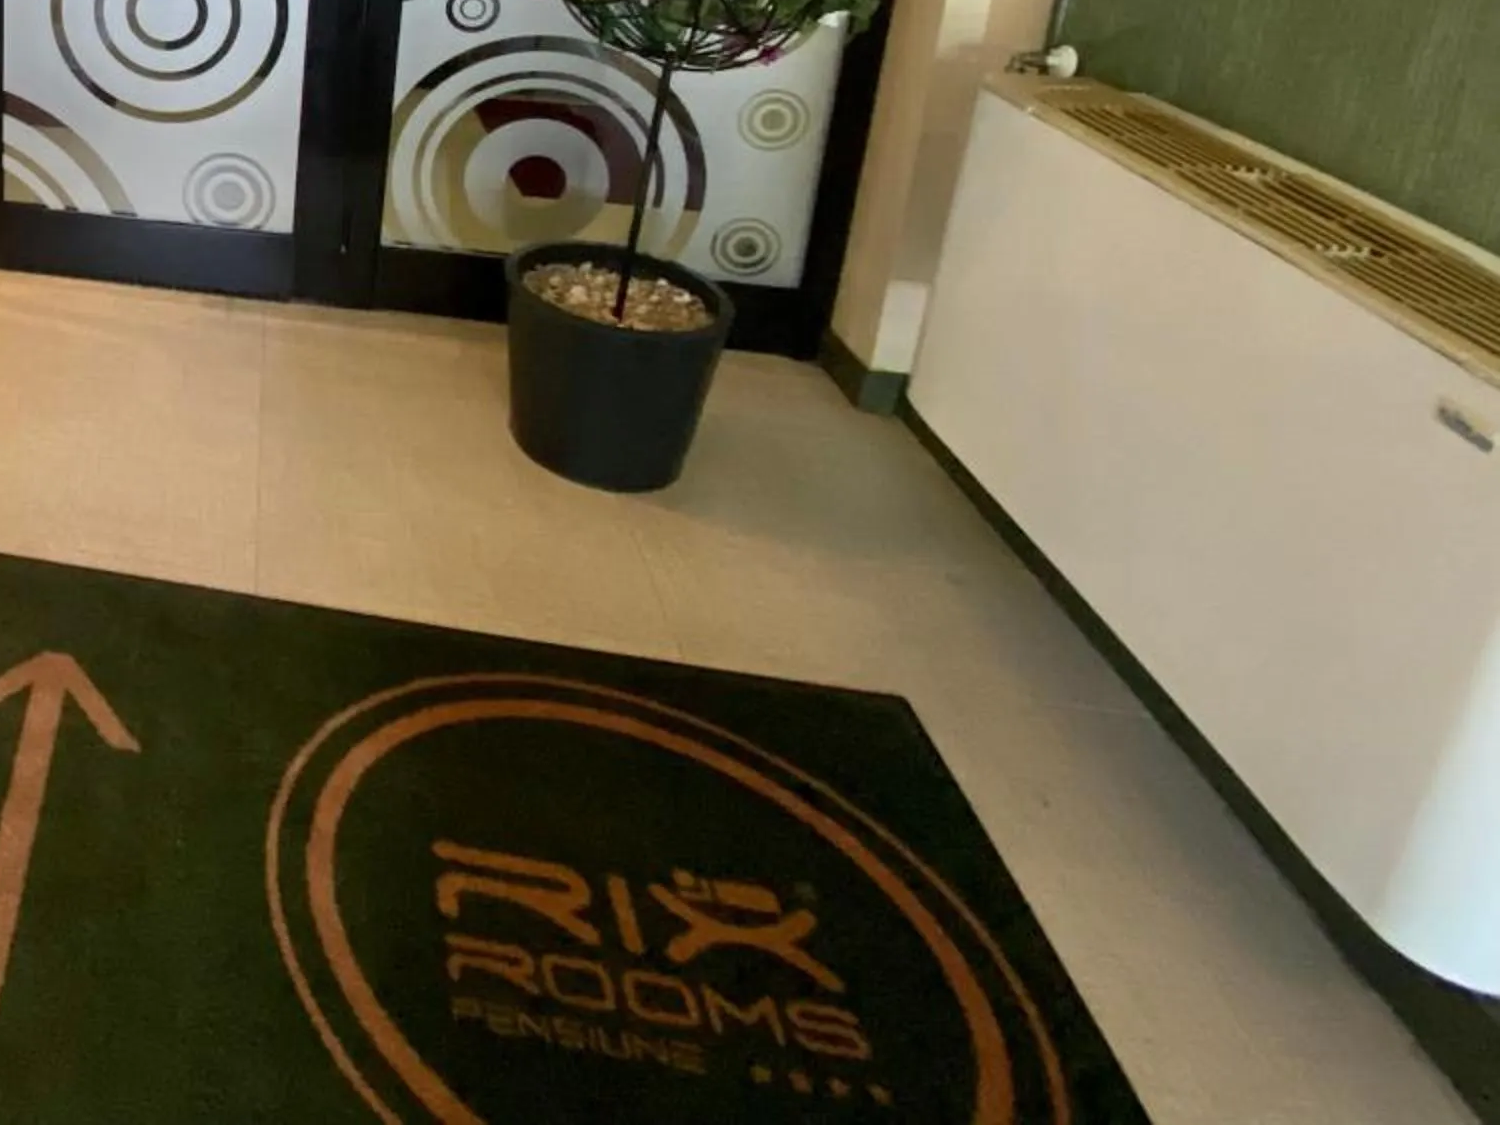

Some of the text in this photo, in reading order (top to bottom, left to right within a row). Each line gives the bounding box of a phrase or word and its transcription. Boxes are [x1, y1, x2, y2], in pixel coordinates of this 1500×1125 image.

[431, 839, 845, 993] RIX
[444, 931, 874, 1061] ROOMS
[450, 996, 706, 1075] PENSIUNE
